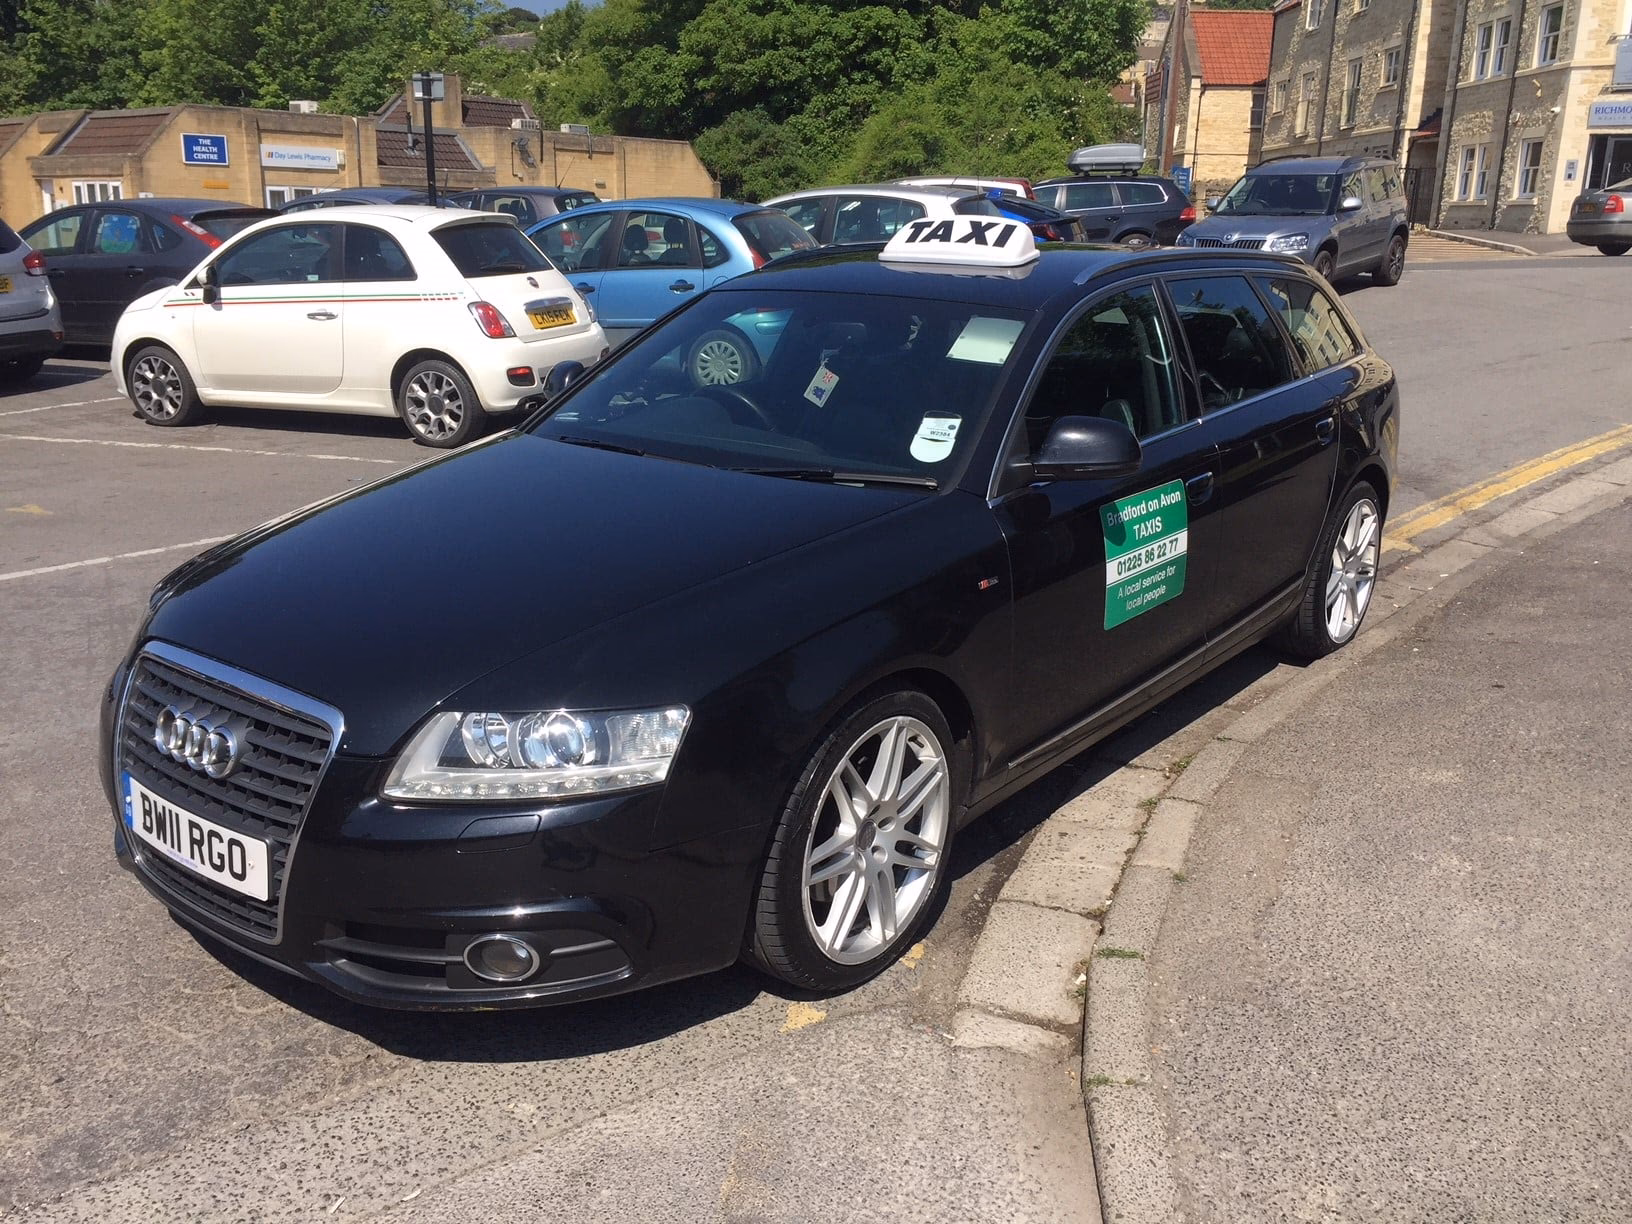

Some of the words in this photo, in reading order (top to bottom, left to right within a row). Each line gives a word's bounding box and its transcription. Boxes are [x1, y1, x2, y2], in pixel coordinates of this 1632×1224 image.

[193, 145, 218, 153] HEALTH
[274, 151, 286, 160] Day
[287, 152, 303, 160] Lewis
[304, 153, 331, 163] Pharmacy
[905, 220, 1017, 248] TAXI
[1107, 501, 1147, 527] Bradford
[1148, 500, 1159, 512] on
[1160, 490, 1181, 508] Avon
[1133, 516, 1162, 540] TAXIS
[1117, 554, 1142, 576] 01225
[1144, 549, 1155, 565] 86
[1157, 542, 1167, 559] 22
[1168, 537, 1179, 553] 77
[1118, 587, 1124, 599] A
[1124, 578, 1141, 597] local
[1142, 570, 1166, 589] service
[1167, 564, 1176, 576] for
[1125, 594, 1142, 611] local
[1143, 585, 1166, 605] people
[188, 819, 247, 882] RGO
